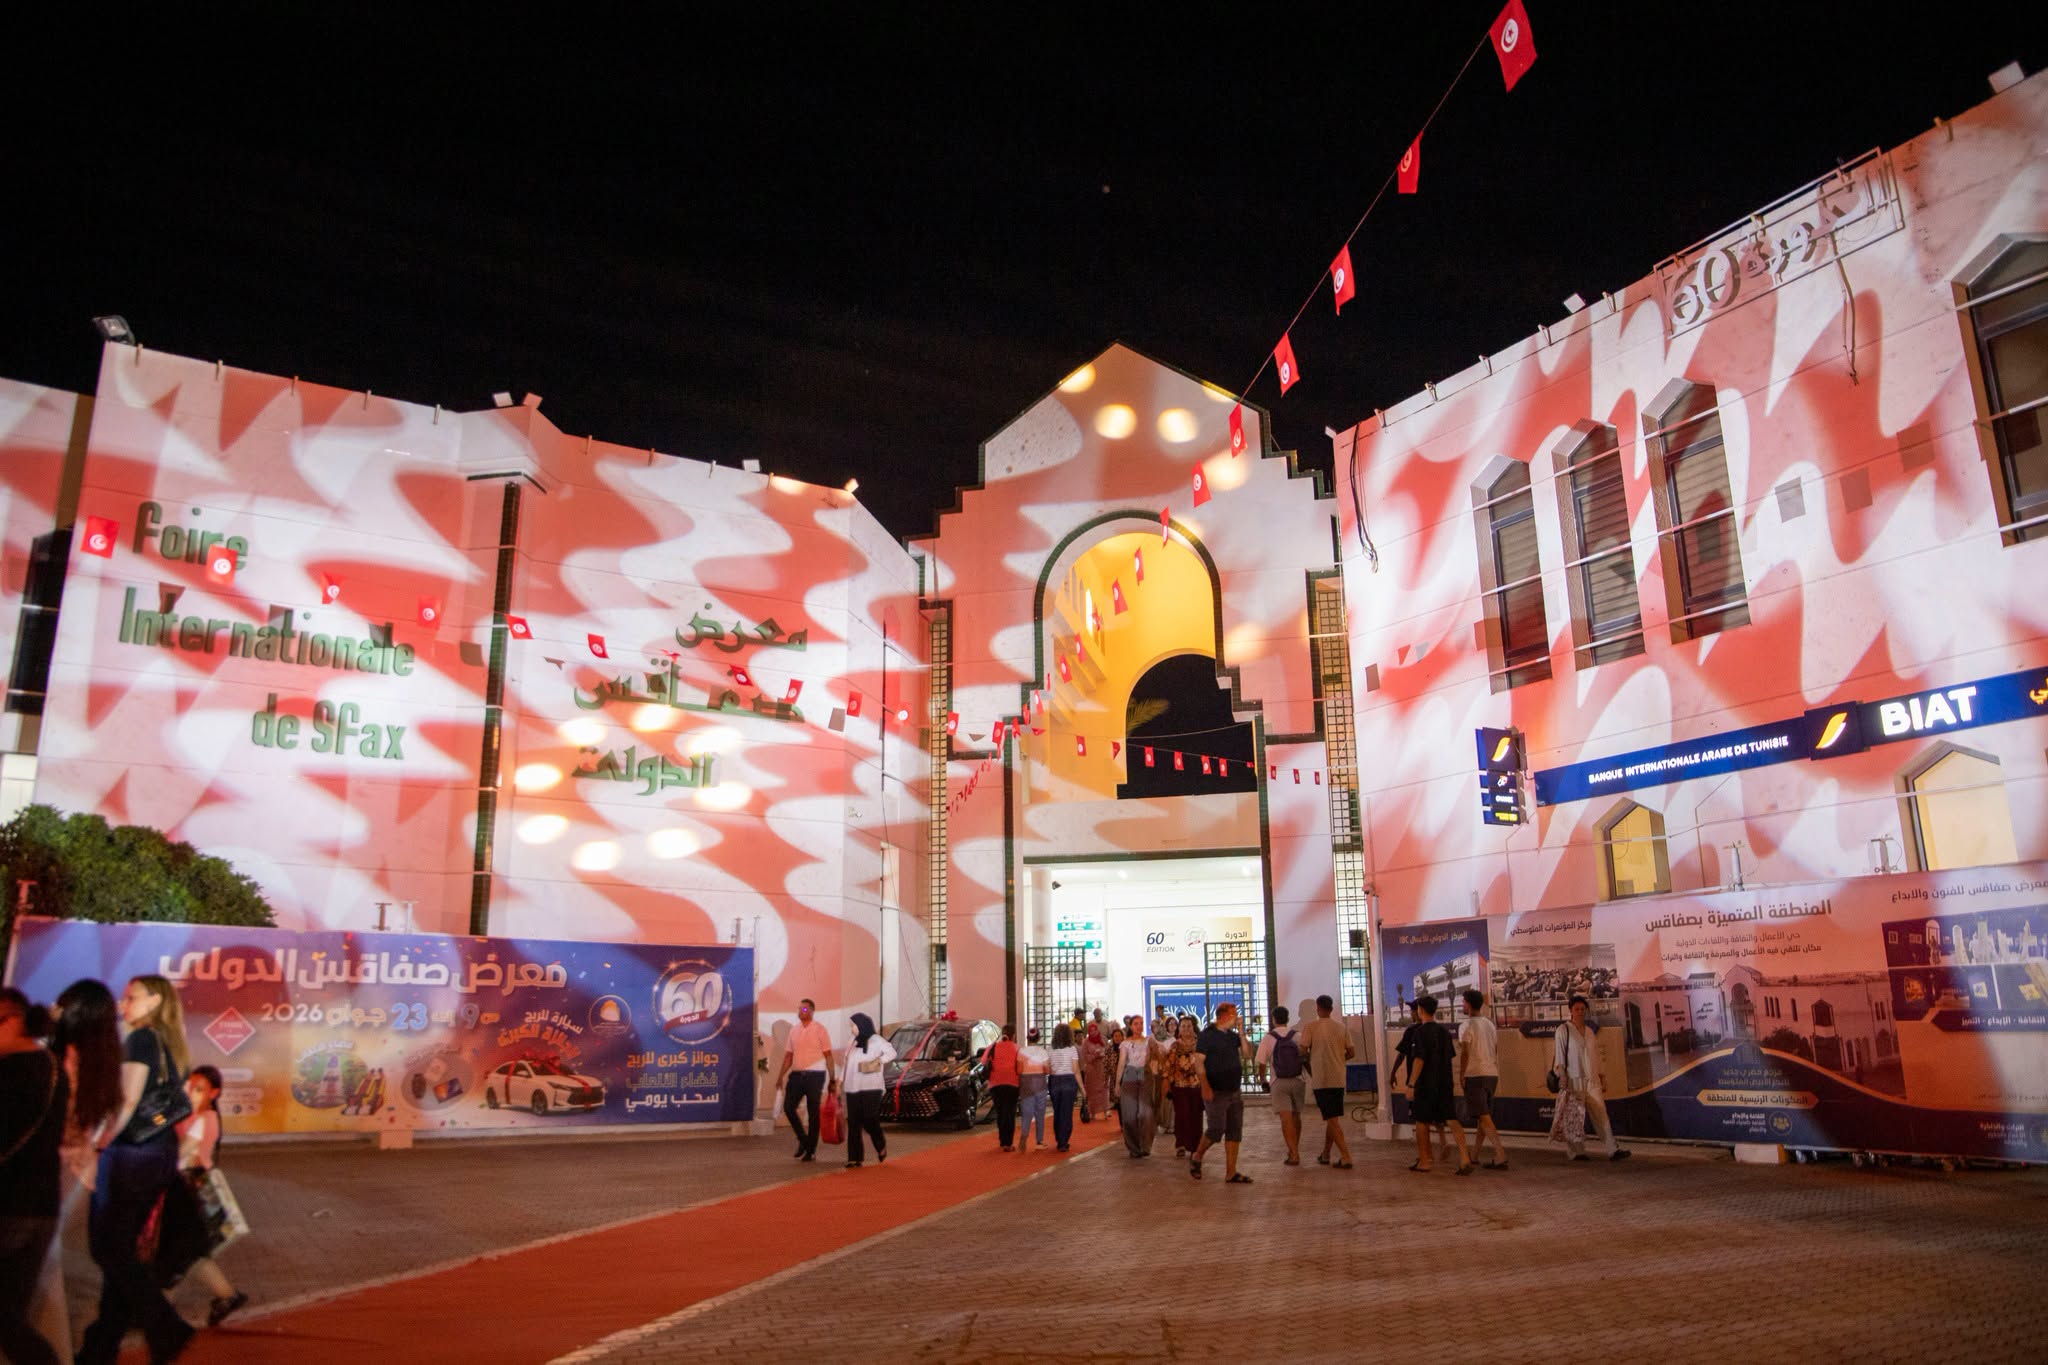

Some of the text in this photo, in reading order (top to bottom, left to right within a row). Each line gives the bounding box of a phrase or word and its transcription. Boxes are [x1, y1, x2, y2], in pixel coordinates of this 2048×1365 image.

[118, 586, 415, 676] Internationale
[675, 602, 808, 652] معرض
[574, 657, 805, 722] صفاقس
[1880, 686, 1976, 736] BIAT
[252, 693, 407, 760] de Sfax
[1588, 735, 1789, 784] BANQUE INTERNATIONALE ARABE DE TUNISIE
[1931, 885, 1965, 899] للفنون
[1968, 882, 2011, 896] صفاقس
[1645, 899, 1832, 932] المنطقة المتميزة بصفاقس
[1146, 932, 1165, 945] 60
[1225, 931, 1248, 940] الدورة
[1510, 921, 1592, 937] مركز المؤتمرات المتوسطي
[1759, 931, 1785, 943] الأعمال
[1787, 932, 1801, 942] حي
[160, 947, 567, 996] معرض صفاقس الدولي
[661, 971, 724, 1022] 60
[260, 1003, 323, 1022] 2026
[391, 1003, 429, 1031] 23
[524, 1009, 550, 1023] للربح
[551, 1011, 584, 1034] سيارة
[679, 1014, 700, 1024] الدورة
[626, 1051, 719, 1068] جوائز كبرى للربح
[625, 1093, 720, 1113] سحب يومي
